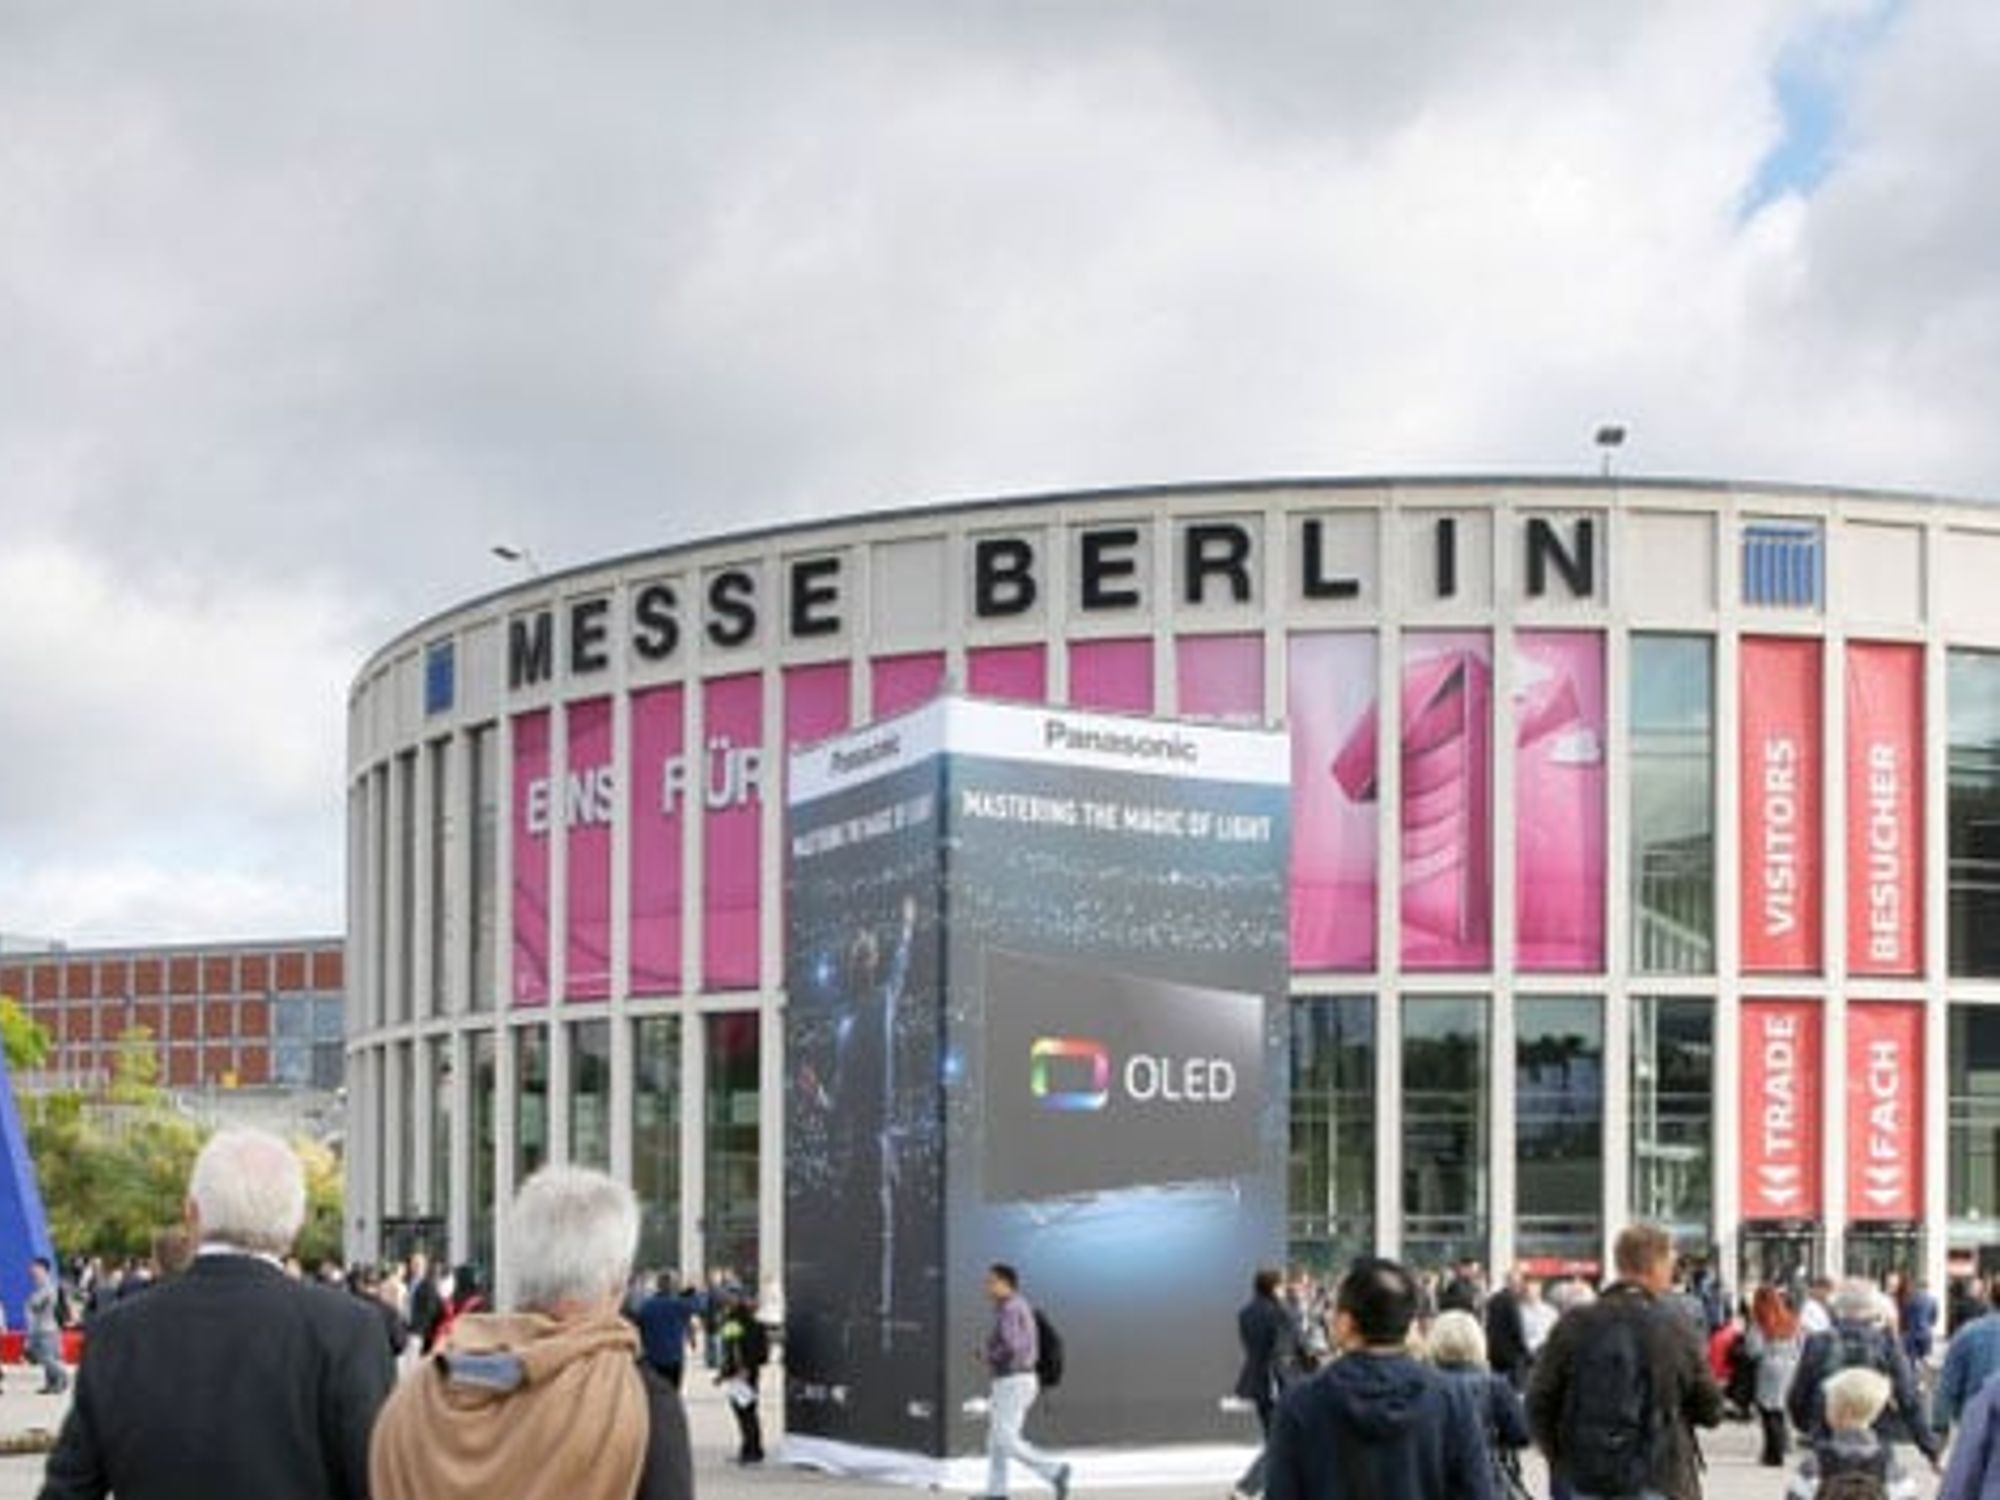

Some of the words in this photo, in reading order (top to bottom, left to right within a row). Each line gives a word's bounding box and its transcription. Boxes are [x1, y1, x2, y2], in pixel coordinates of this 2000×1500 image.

[508, 557, 841, 690] MESSE
[974, 516, 1595, 618] BERLIN
[528, 764, 613, 834] ENS
[1045, 720, 1198, 762] Panasonic
[1765, 739, 1796, 936] VISITORS
[1870, 744, 1899, 961] BESUCHER
[1124, 1054, 1236, 1101] OLED
[1765, 1015, 1796, 1155] TRADE
[1870, 1042, 1898, 1157] FACH
